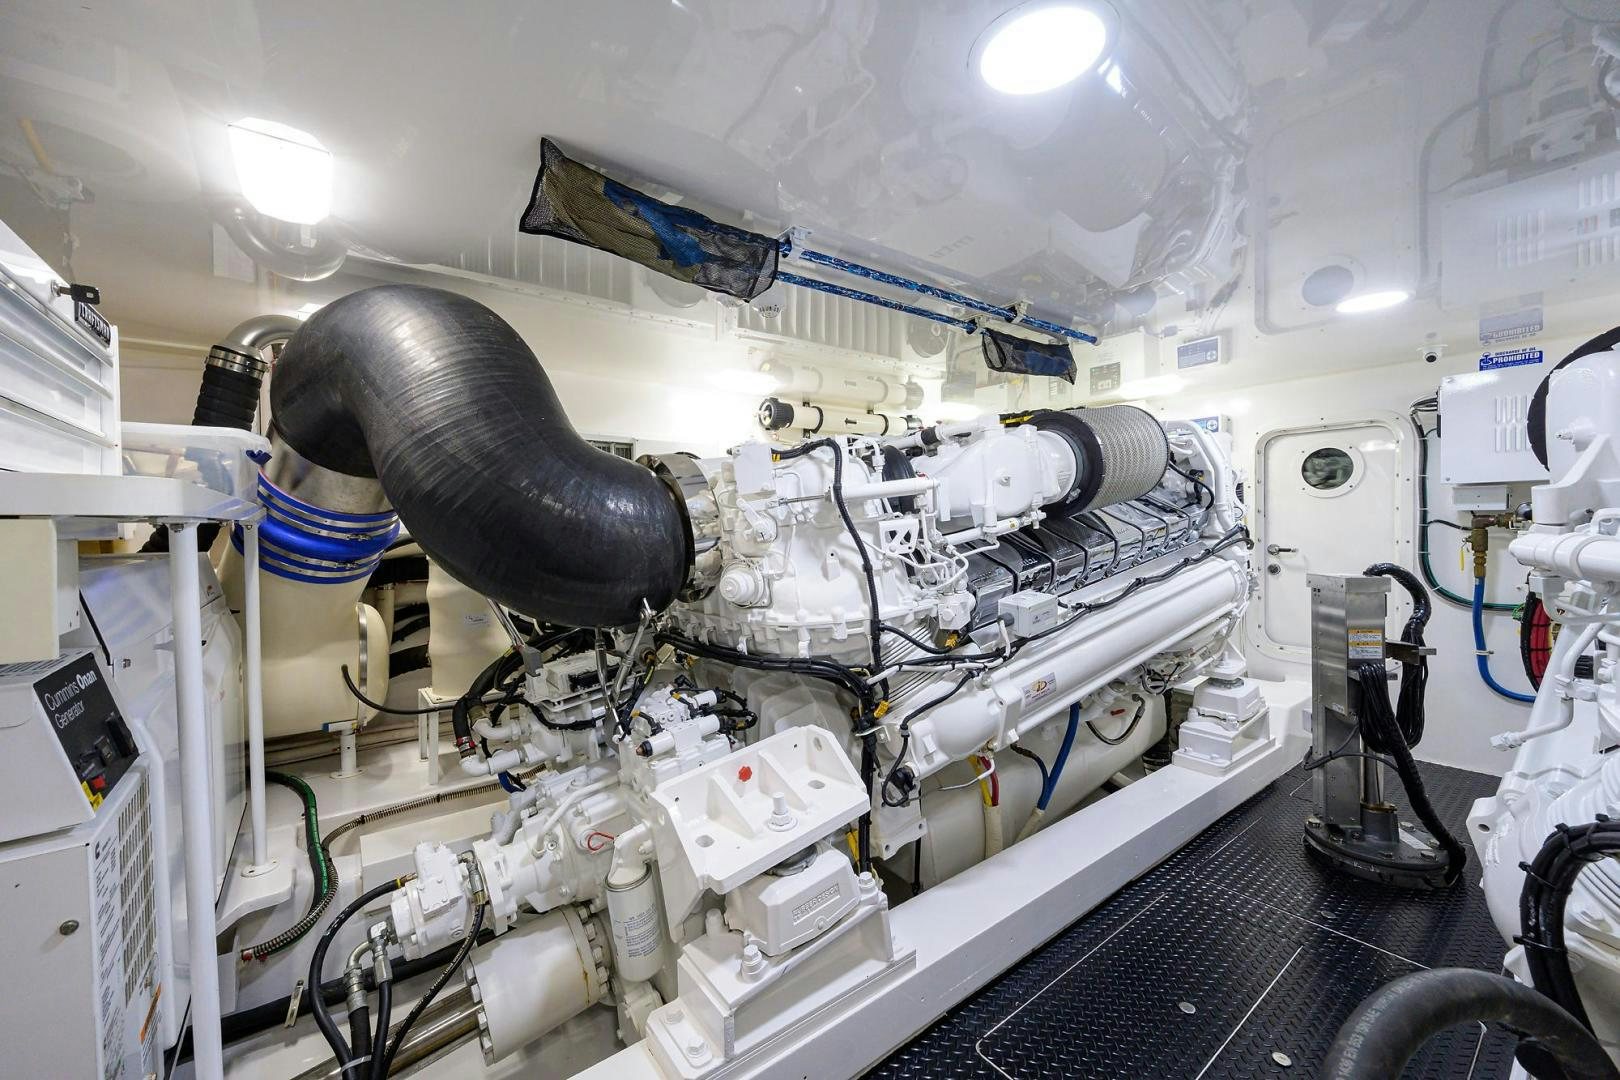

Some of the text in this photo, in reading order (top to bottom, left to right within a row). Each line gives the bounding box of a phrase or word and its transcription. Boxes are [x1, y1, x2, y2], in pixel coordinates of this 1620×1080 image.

[1492, 351, 1541, 364] PROHIBITED
[44, 669, 98, 711] Cummins Onan
[54, 700, 85, 729] Generator
